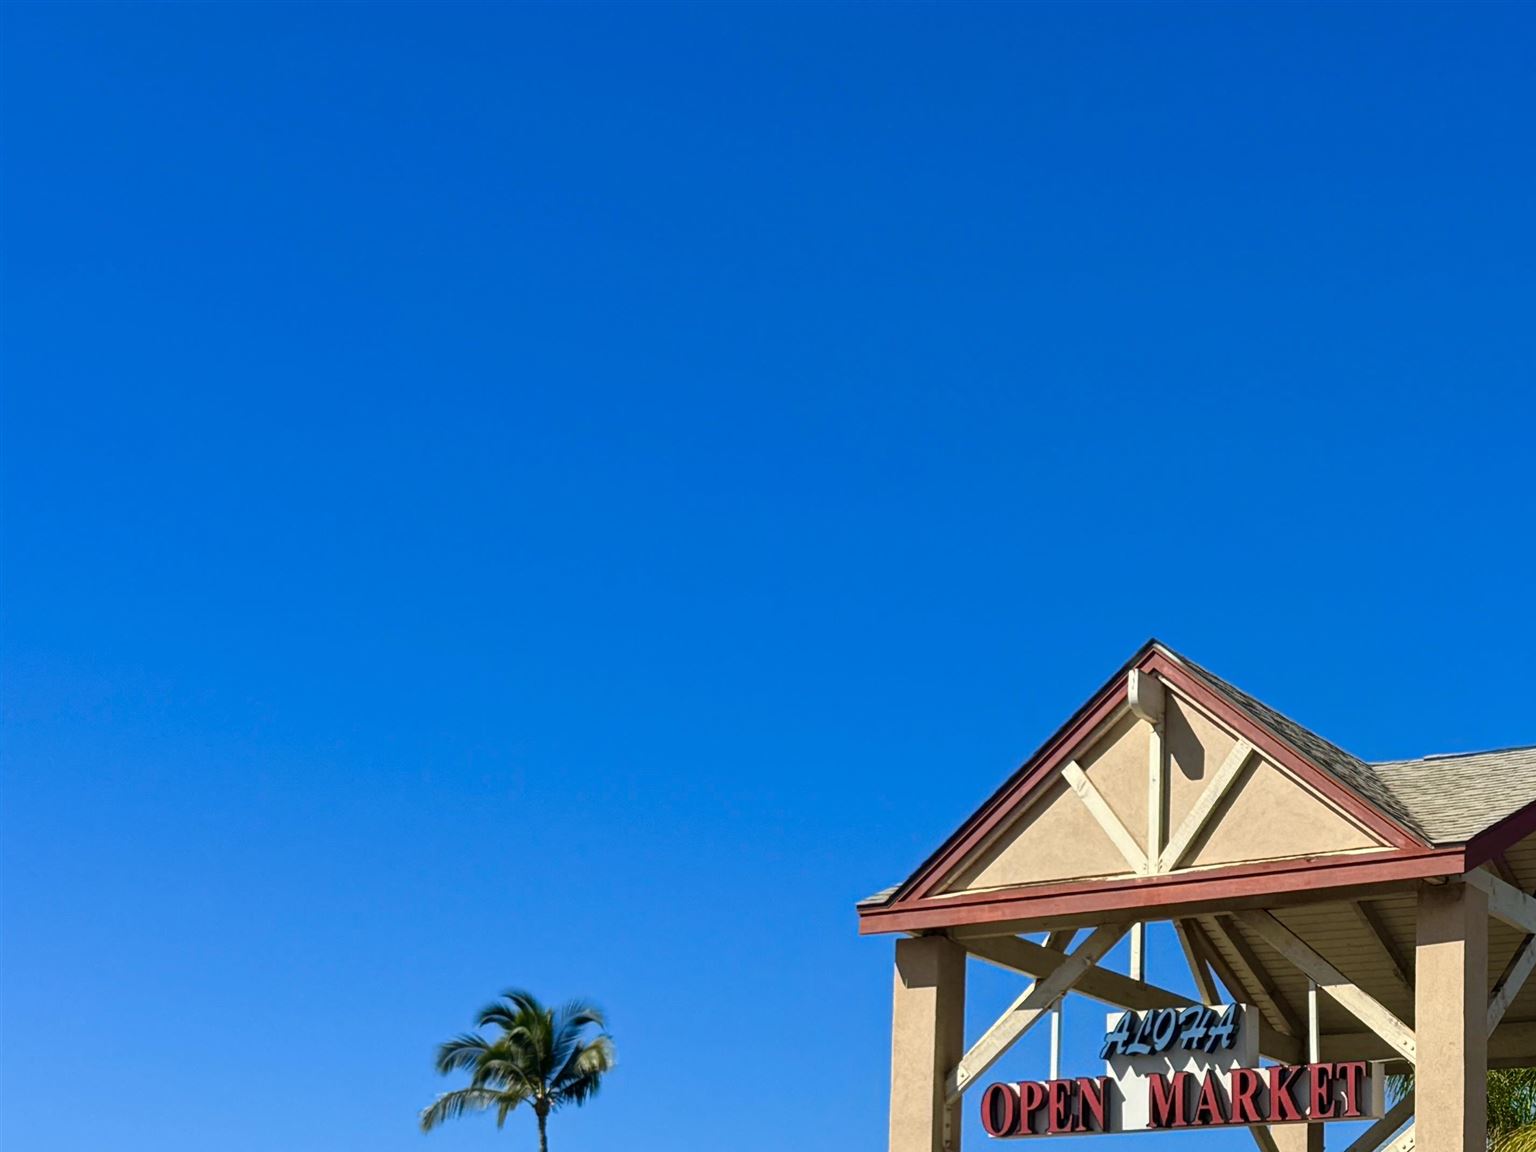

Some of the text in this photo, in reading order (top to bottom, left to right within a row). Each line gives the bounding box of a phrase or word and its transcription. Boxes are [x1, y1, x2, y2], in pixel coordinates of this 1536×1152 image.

[1101, 1003, 1238, 1058] ALOHA
[980, 1061, 1366, 1137] OPEN MARKET
